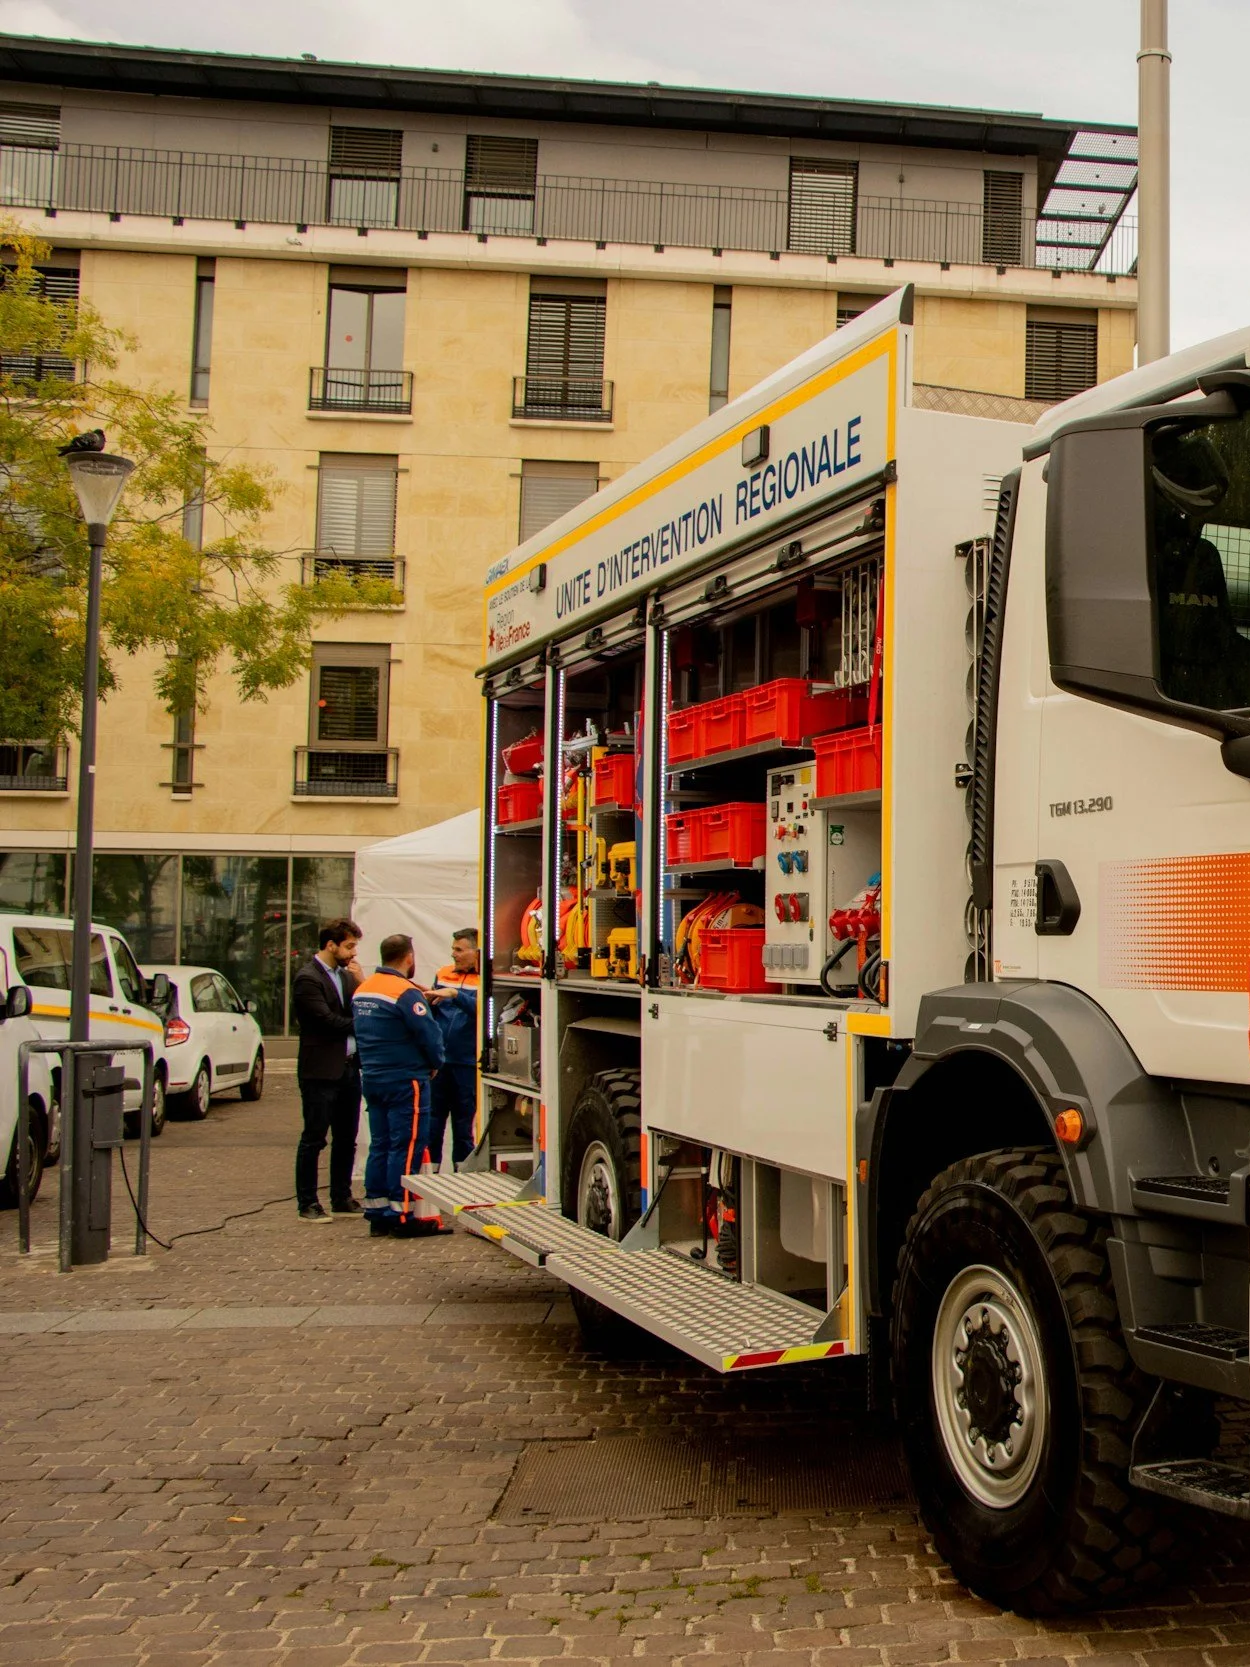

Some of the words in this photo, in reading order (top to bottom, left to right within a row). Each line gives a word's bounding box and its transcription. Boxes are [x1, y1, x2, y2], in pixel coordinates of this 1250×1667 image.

[556, 568, 591, 620] UNITE
[597, 493, 723, 598] D'INTERVENTION
[735, 415, 862, 526] REGIONALE
[1168, 592, 1219, 608] MAN
[1049, 801, 1072, 818] TGM
[1073, 796, 1113, 815] 13.290
